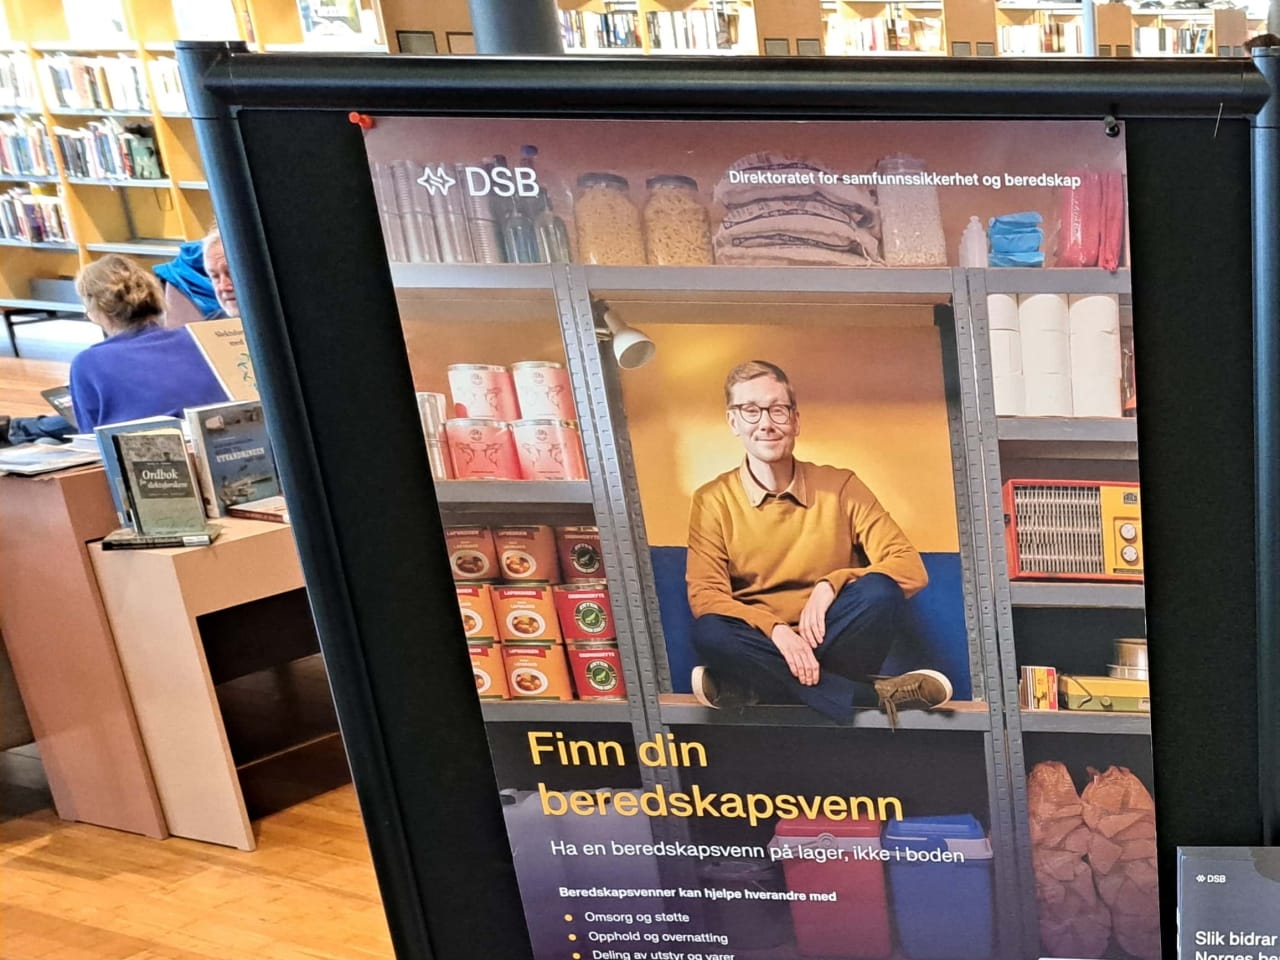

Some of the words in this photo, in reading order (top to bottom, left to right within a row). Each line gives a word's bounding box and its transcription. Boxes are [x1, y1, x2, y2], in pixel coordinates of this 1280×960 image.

[468, 167, 539, 196] DSB
[729, 169, 816, 186] Direktoratet
[818, 170, 839, 186] for
[842, 171, 978, 188] samfunnssikkerhet
[982, 175, 1001, 191] og
[1004, 172, 1081, 191] beredskap
[527, 731, 625, 766] Finn
[639, 732, 707, 767] din
[540, 782, 904, 826] beredskapsvenn
[551, 841, 577, 857] Ha
[582, 845, 606, 857] en
[610, 841, 765, 862] beredskapsvenn
[770, 841, 794, 864] på
[798, 844, 849, 863] lager,
[853, 845, 889, 862] ikke
[897, 847, 902, 862] i
[905, 847, 965, 863] boden
[1207, 875, 1226, 883] DSB
[559, 886, 677, 901] Beredskapsvenner
[679, 889, 701, 899] kan
[704, 888, 741, 903] hjelpe
[745, 890, 806, 901] hverandre
[809, 890, 837, 902] med
[584, 911, 630, 926] Omsorg
[634, 915, 649, 926] og
[652, 912, 689, 923] støtte
[588, 931, 641, 944] Opphold
[644, 934, 659, 945] og
[661, 932, 728, 945] overnatting
[1195, 931, 1225, 947] Slik
[1230, 931, 1278, 947] bidrar
[632, 952, 647, 960] av
